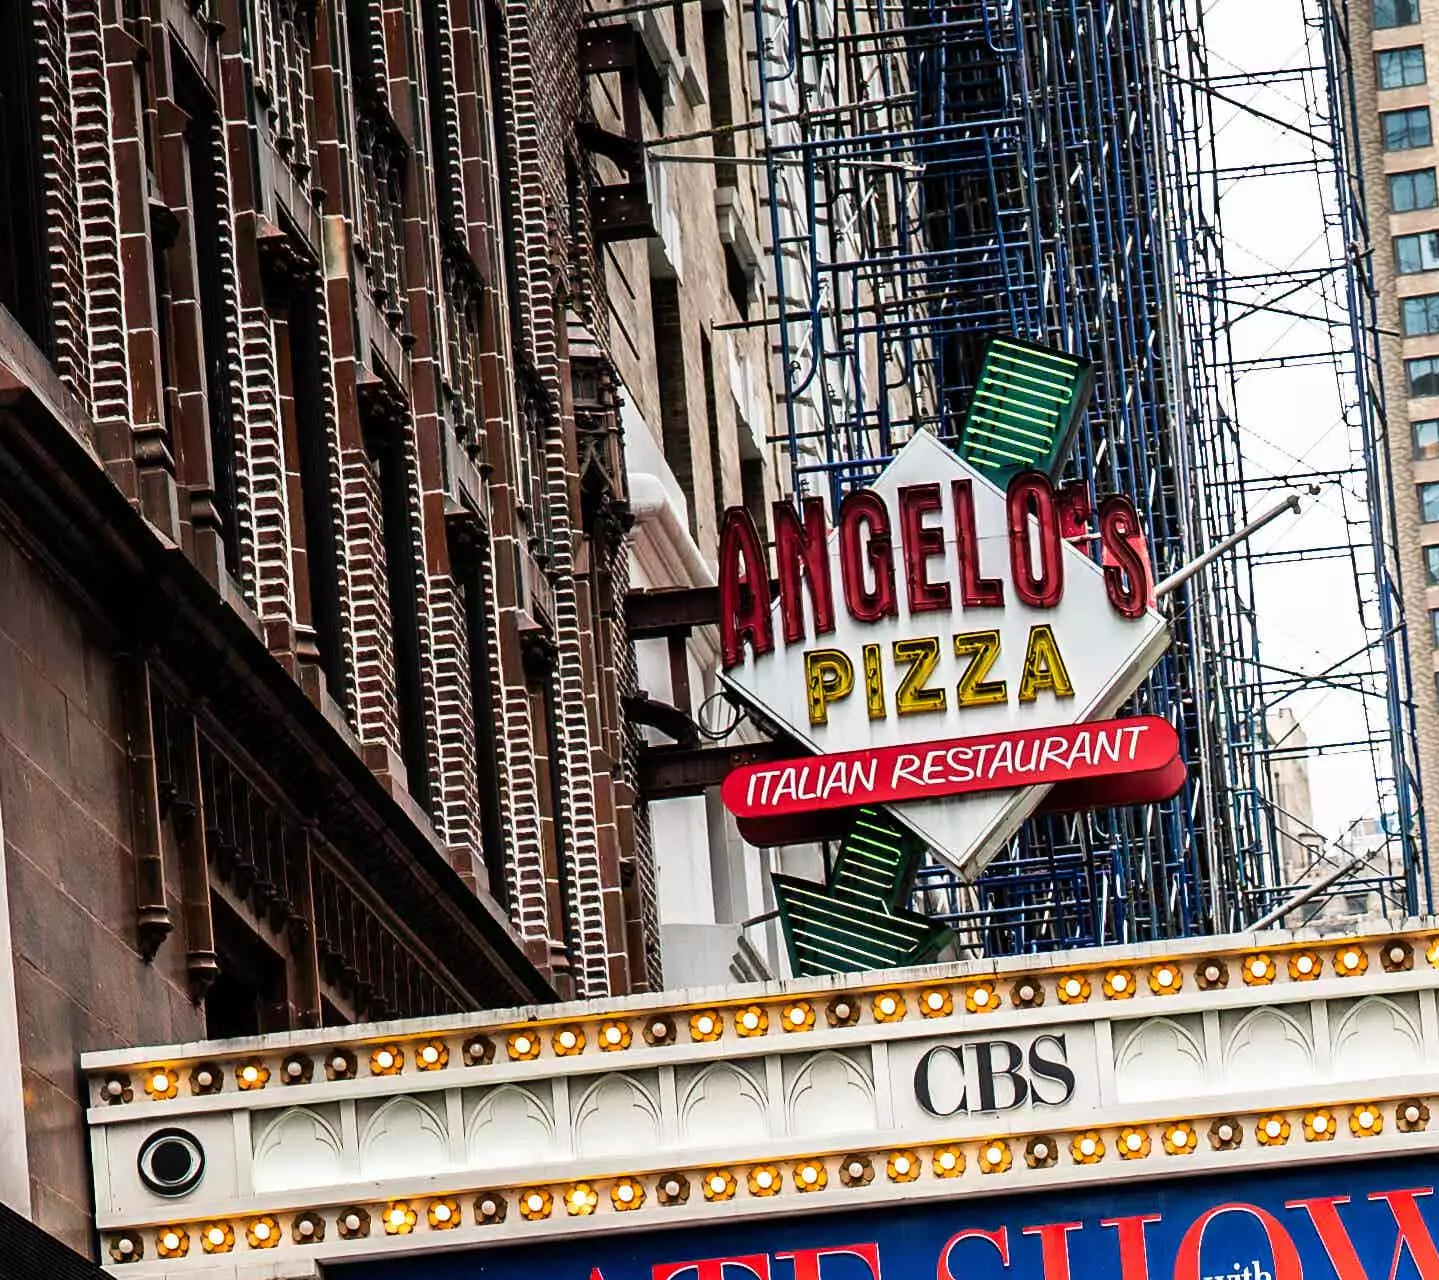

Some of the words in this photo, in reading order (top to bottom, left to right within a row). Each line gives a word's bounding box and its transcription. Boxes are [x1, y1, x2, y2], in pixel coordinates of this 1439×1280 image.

[718, 472, 1148, 669] ANGELO'S
[803, 623, 1075, 726] PIZZA
[747, 757, 880, 806] ITALIAN
[891, 725, 1148, 789] RESTAURANT
[913, 1032, 1077, 1119] CBS
